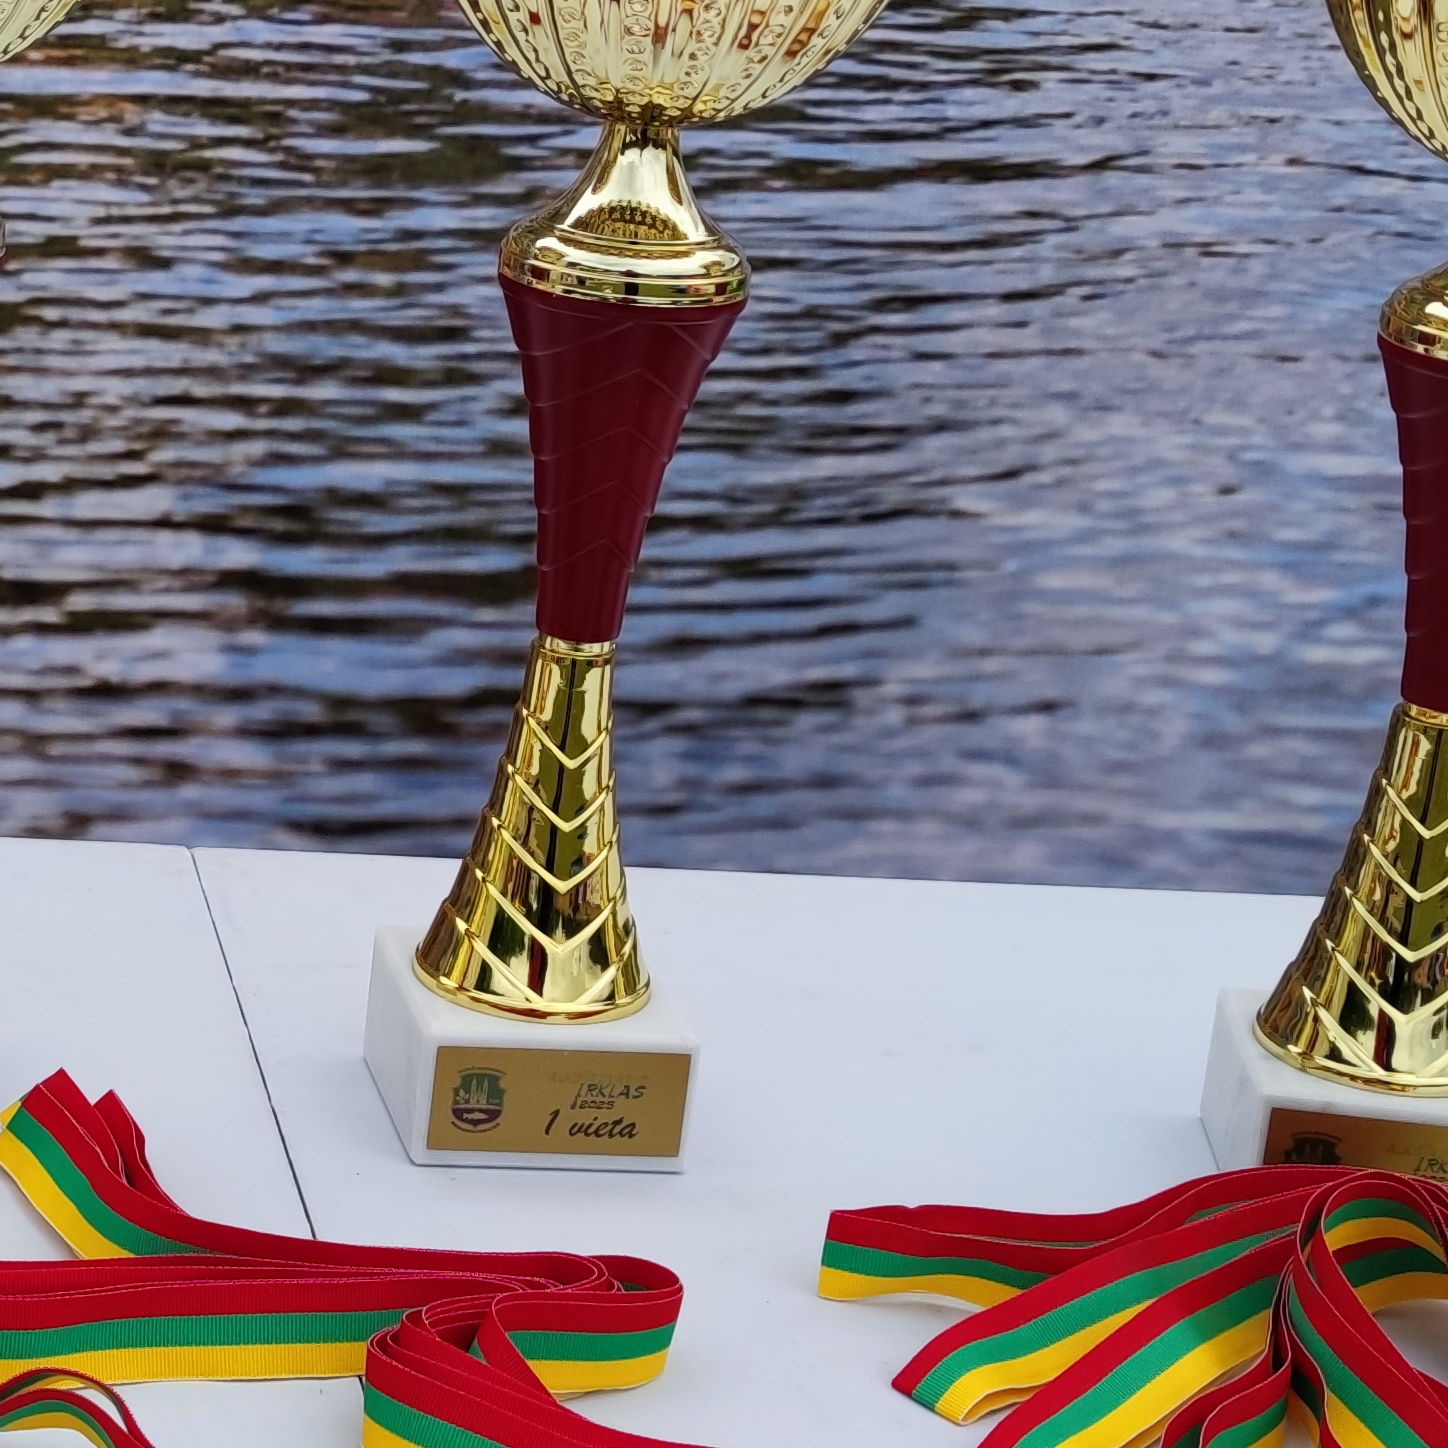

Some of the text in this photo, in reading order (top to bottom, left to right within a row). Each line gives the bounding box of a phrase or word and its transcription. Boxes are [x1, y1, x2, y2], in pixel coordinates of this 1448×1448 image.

[570, 1083, 648, 1110] IRKLAS
[578, 1100, 616, 1110] 2025
[544, 1108, 639, 1140] 1 vieta
